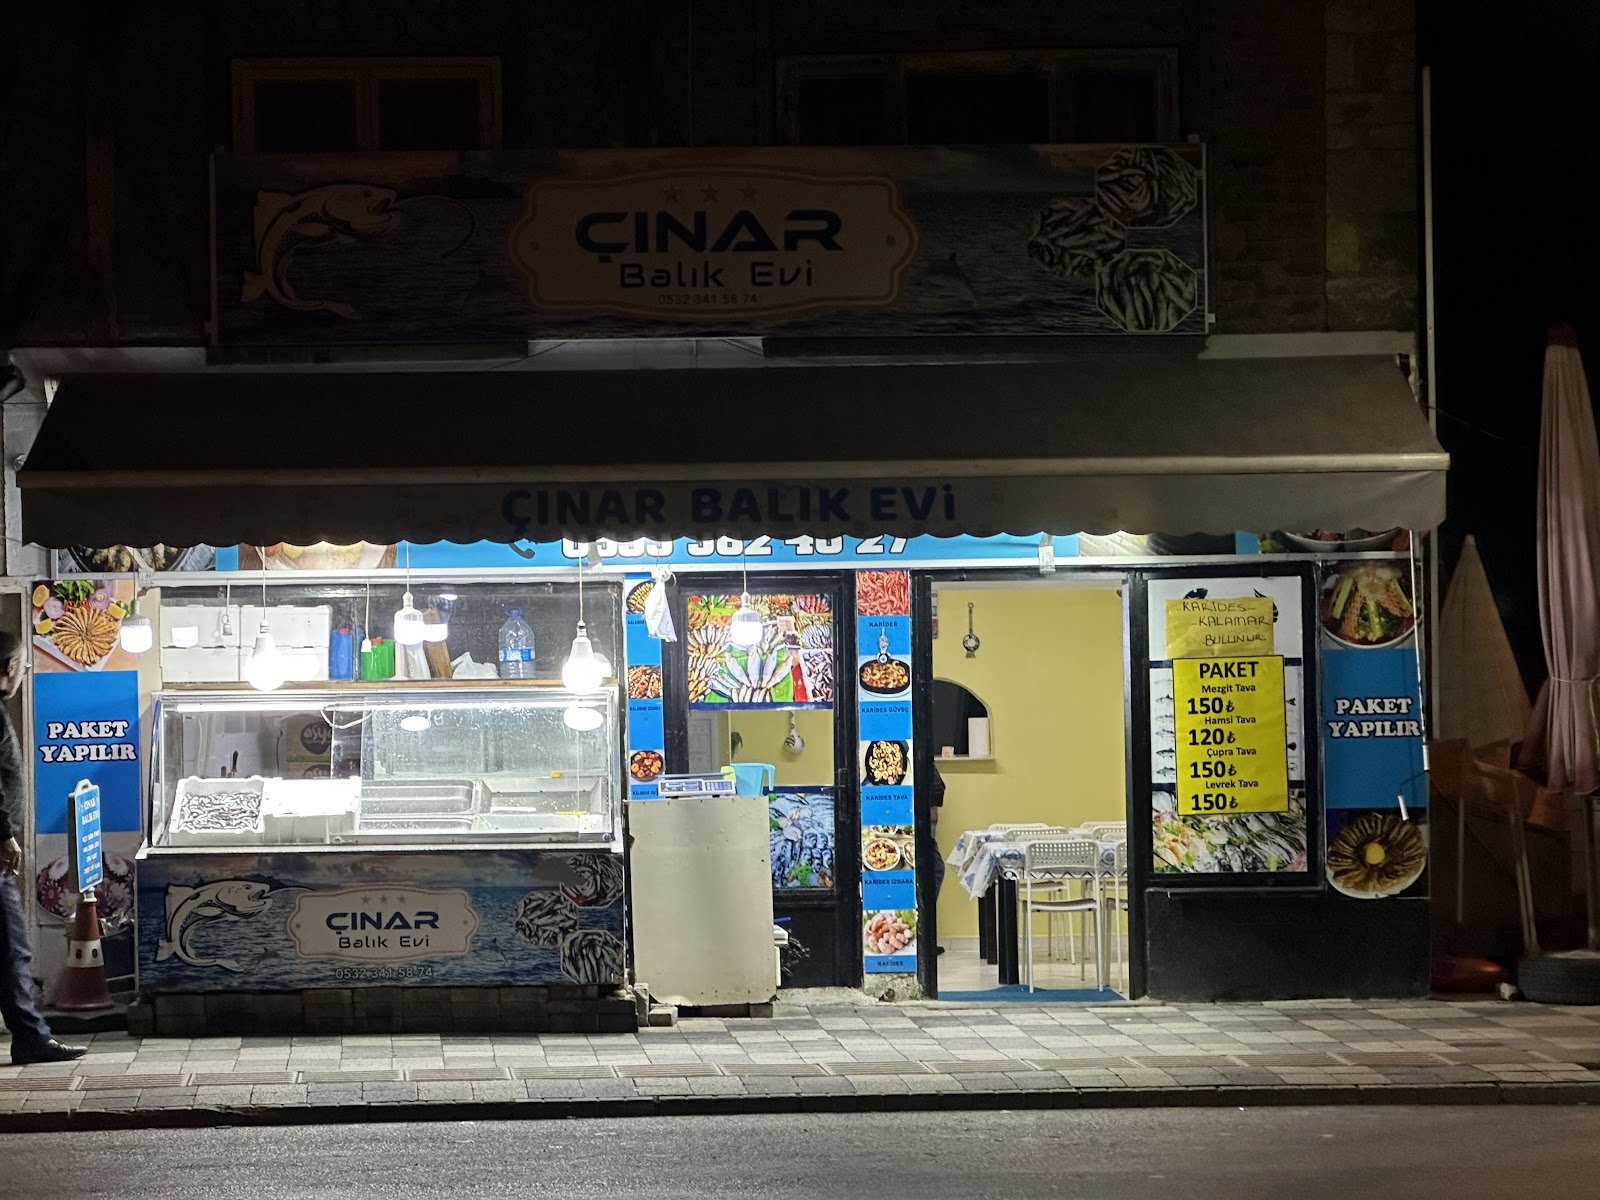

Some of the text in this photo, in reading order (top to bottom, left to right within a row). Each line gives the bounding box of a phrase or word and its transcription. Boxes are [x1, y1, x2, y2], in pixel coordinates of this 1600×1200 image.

[576, 210, 843, 262] ÇINAR
[621, 259, 813, 287] Balık Evi
[658, 294, 758, 305] 0532 341 58 74
[503, 488, 665, 533] ÇINAR
[692, 487, 851, 522] BALIK
[1200, 662, 1259, 679] PAKET
[1202, 684, 1256, 694] Mezgit Tava
[1336, 698, 1412, 715] PAKET
[1205, 715, 1256, 725] Hamsi Tava
[47, 720, 129, 739] PAKET
[1328, 721, 1421, 737] YAPILIR
[40, 743, 137, 762] YAPILIR
[1206, 747, 1257, 758] Çupra Tava
[1205, 780, 1258, 789] Levrek Tava
[325, 911, 439, 934] ÇINAR
[338, 934, 429, 949] Balık Evi
[335, 966, 433, 979] 0532 341 58 74
